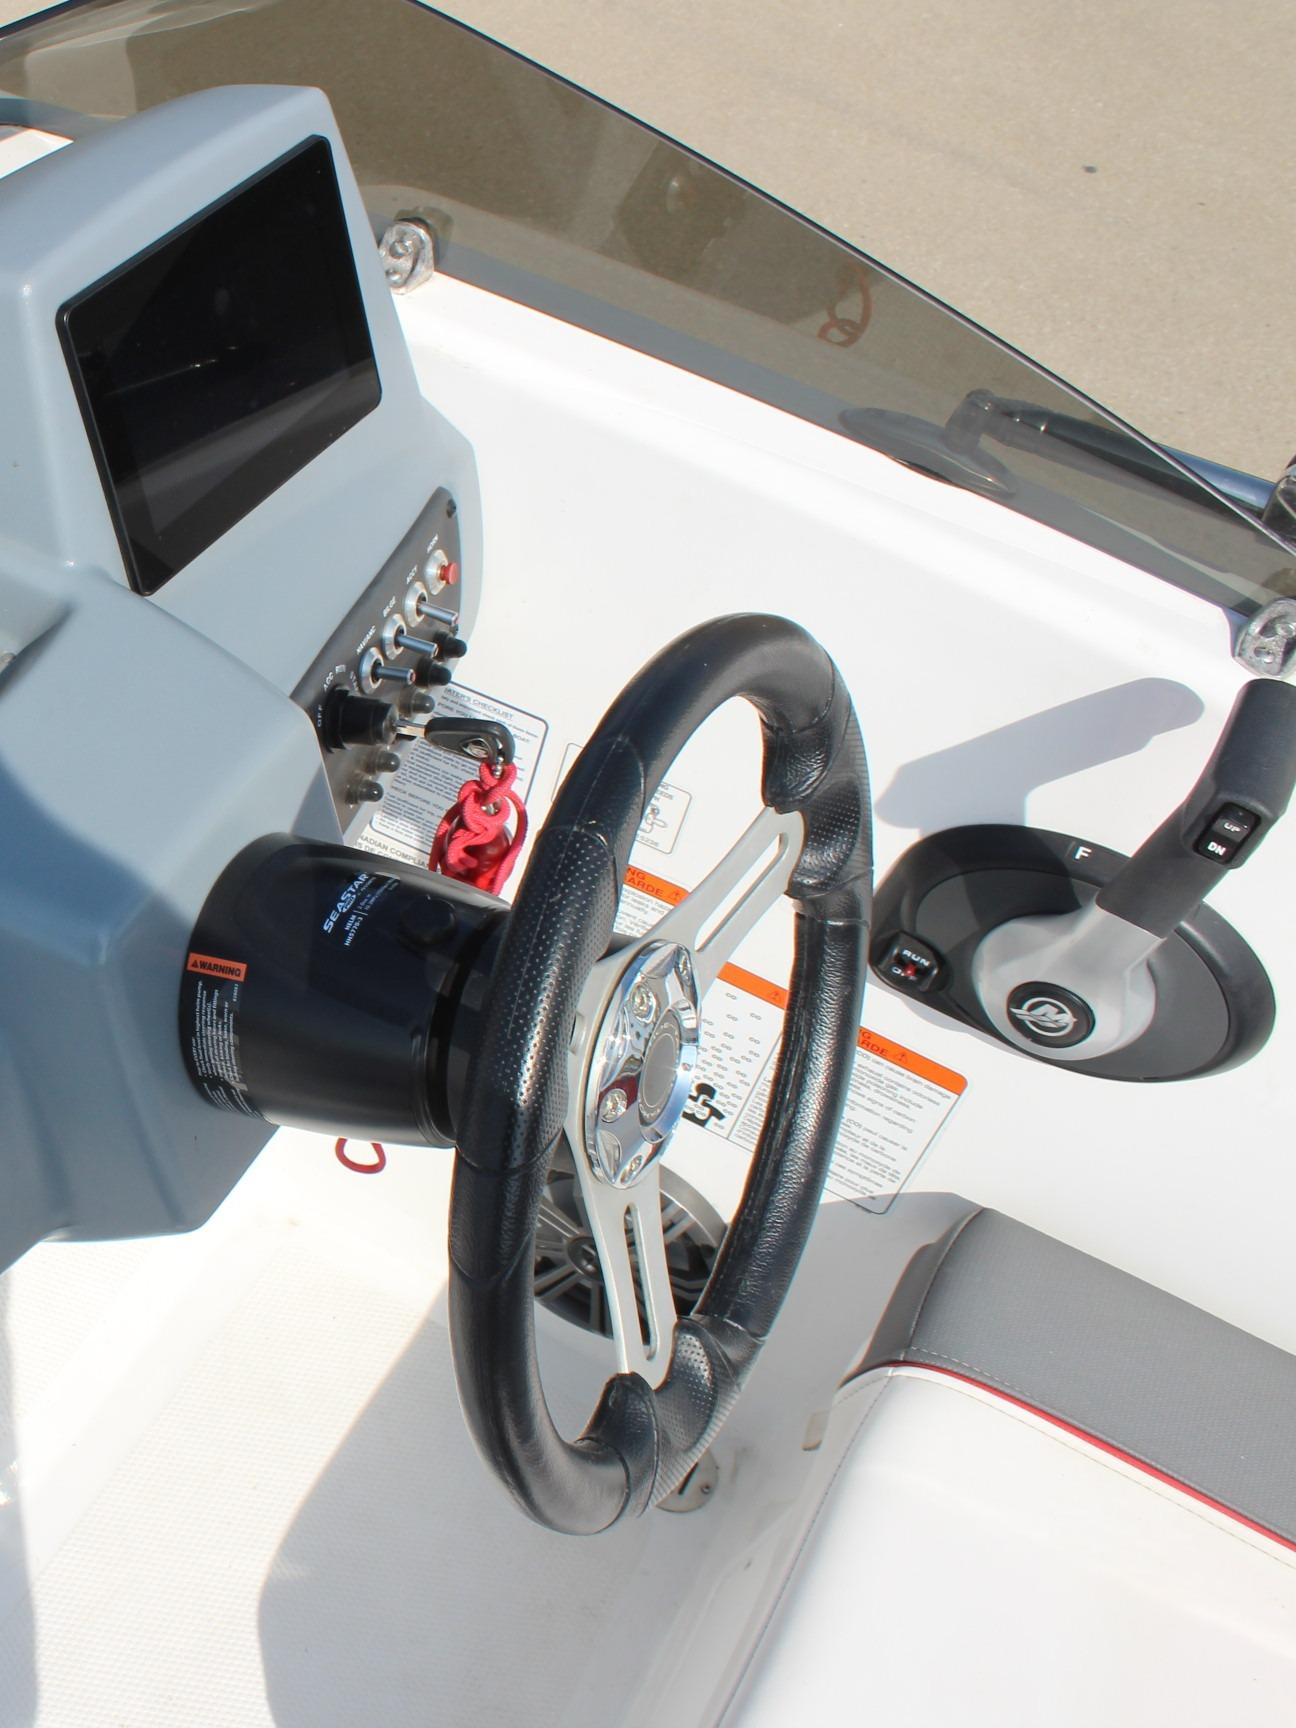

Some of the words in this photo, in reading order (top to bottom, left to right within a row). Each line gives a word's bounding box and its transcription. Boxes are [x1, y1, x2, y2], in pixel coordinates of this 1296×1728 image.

[1223, 822, 1241, 832] UP
[1073, 846, 1092, 862] F
[1207, 841, 1227, 856] DN
[323, 873, 368, 933] SEASTAR
[902, 949, 930, 966] RUN
[198, 960, 241, 977] WARNING
